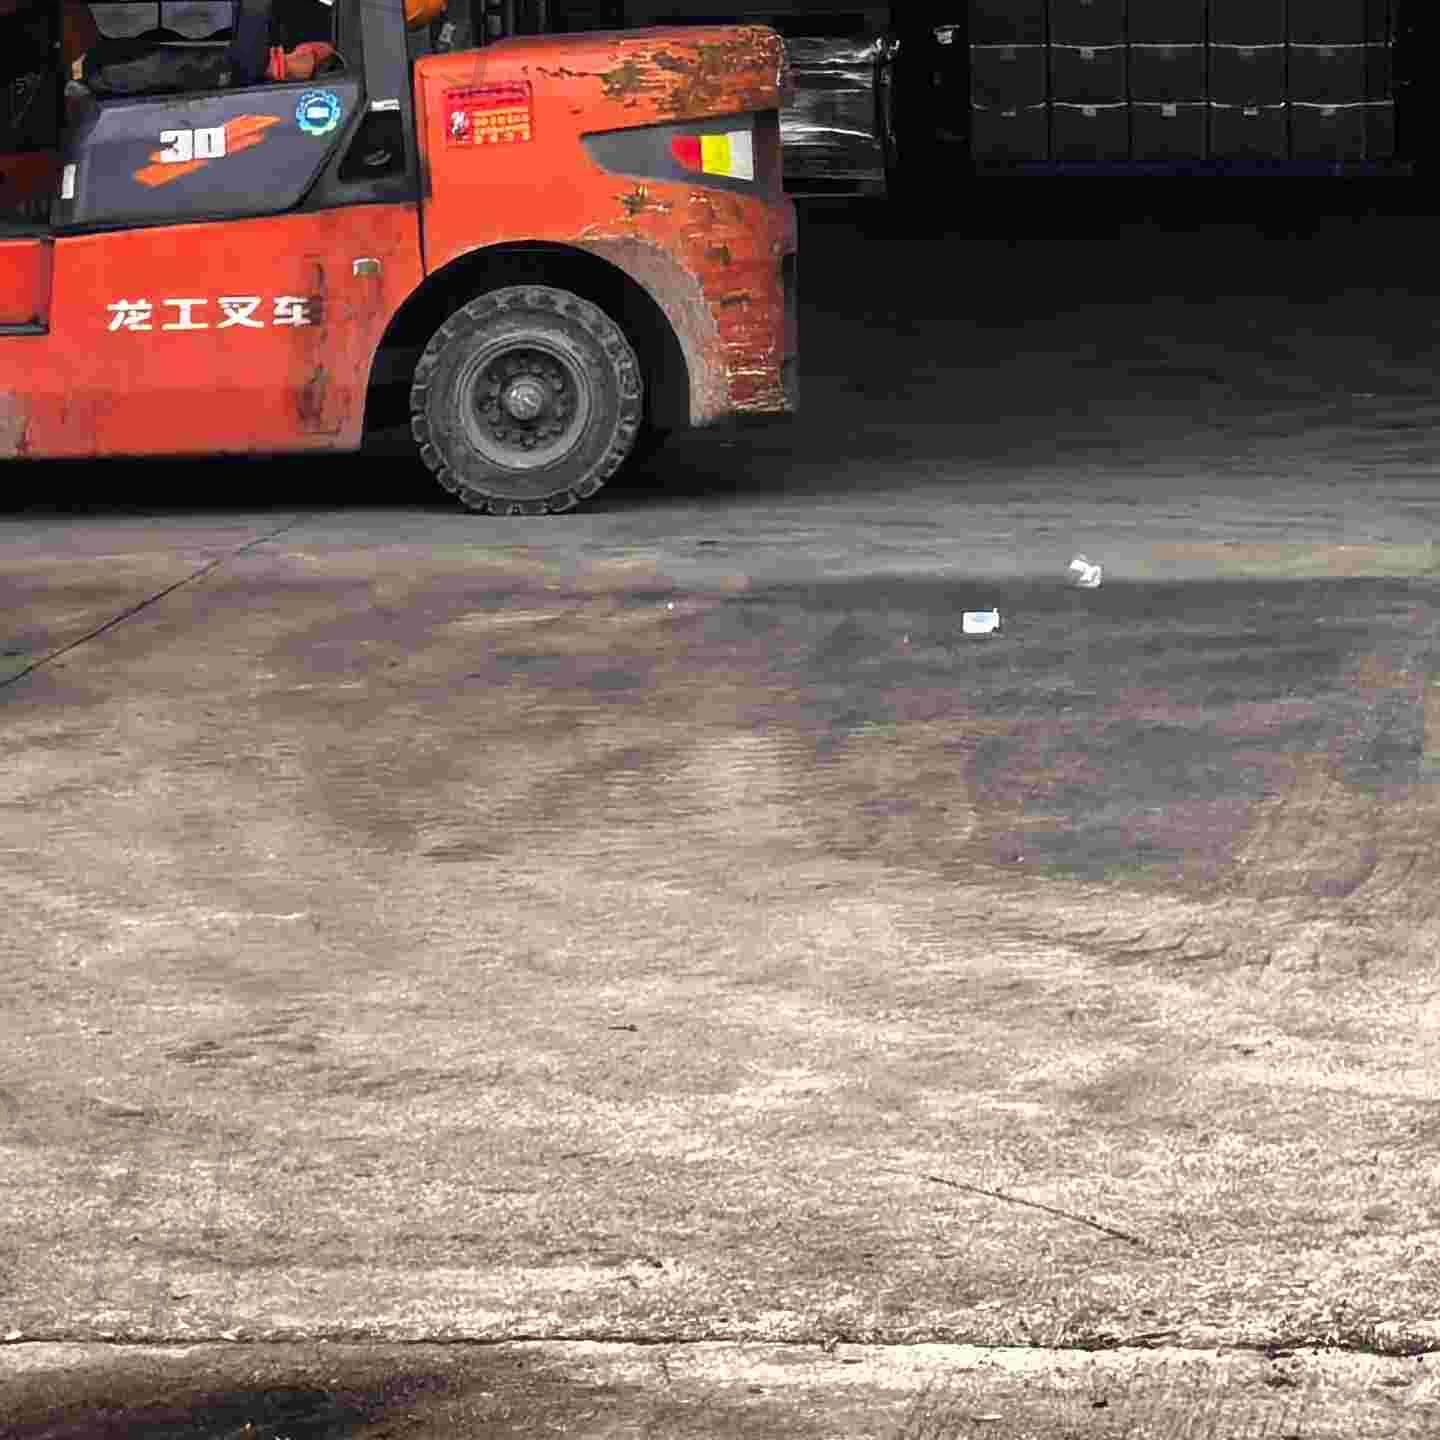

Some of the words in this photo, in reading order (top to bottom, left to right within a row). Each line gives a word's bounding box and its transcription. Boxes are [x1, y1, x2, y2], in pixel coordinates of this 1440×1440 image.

[160, 126, 227, 164] 30
[106, 296, 313, 332] 龙工叉车
